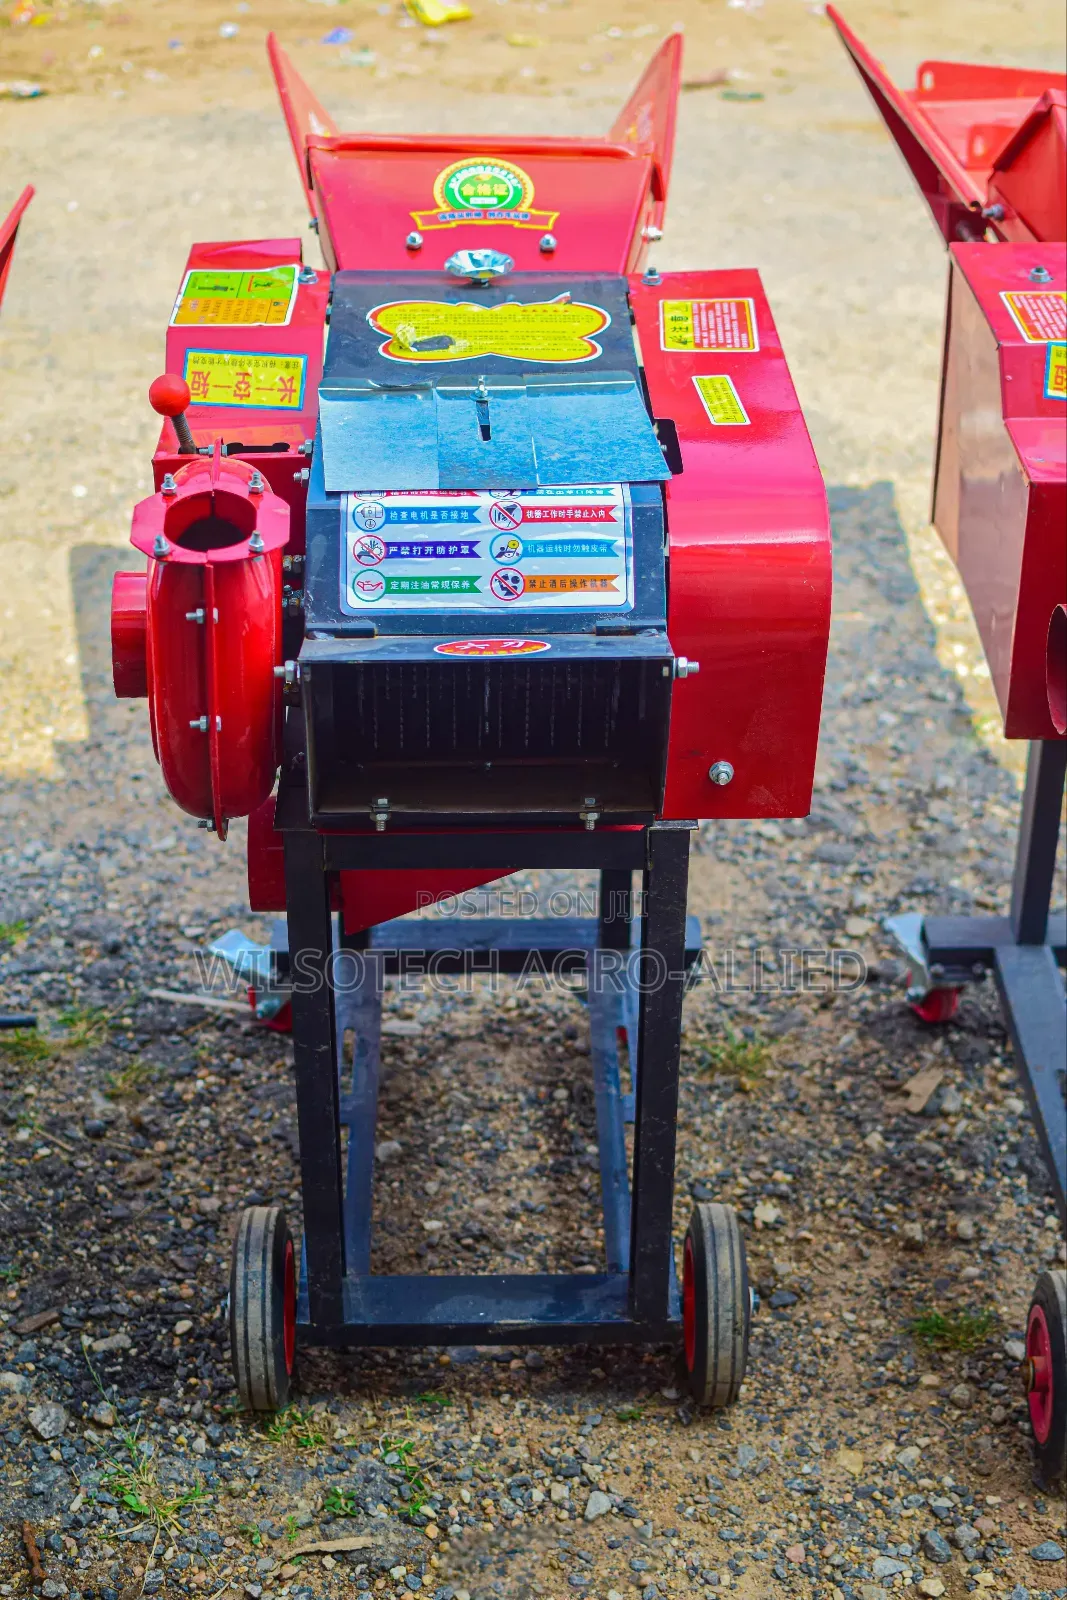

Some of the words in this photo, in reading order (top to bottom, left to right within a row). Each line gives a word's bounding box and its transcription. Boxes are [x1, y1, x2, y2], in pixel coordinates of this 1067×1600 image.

[390, 510, 469, 520] 检查电机是否接地
[526, 509, 606, 519] 机器工作时手禁止入内
[389, 545, 470, 555] 严禁打开防护罩
[527, 544, 608, 553] 机器运转时勿触皮带
[390, 580, 470, 590] 定期注油常规保养
[528, 579, 608, 589] 禁止酒后操作机器
